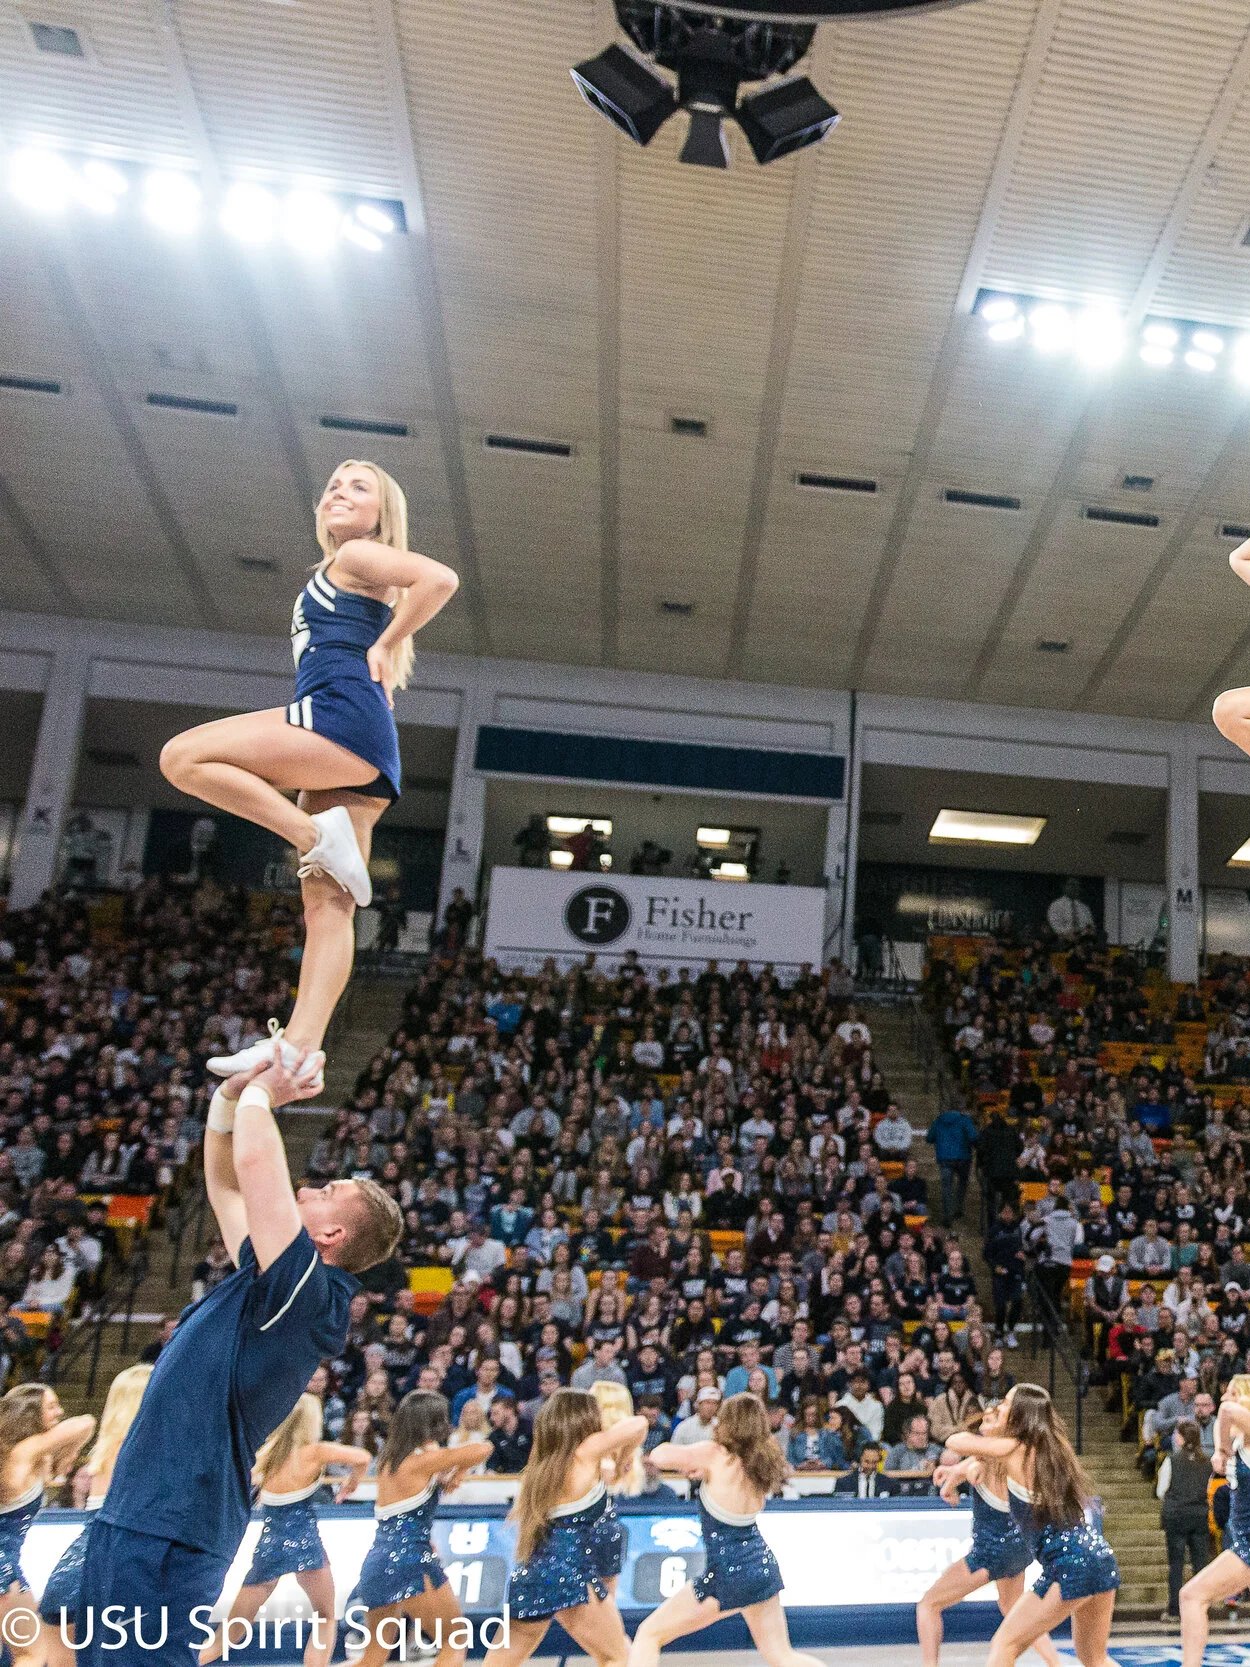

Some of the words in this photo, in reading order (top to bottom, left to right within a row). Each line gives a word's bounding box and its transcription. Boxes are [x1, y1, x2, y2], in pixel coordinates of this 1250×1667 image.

[456, 839, 470, 856] L
[645, 895, 753, 932] Fisher
[1177, 888, 1193, 903] M
[583, 897, 615, 933] F
[637, 927, 677, 942] Home
[443, 1561, 484, 1603] 11
[659, 1556, 687, 1598] 6
